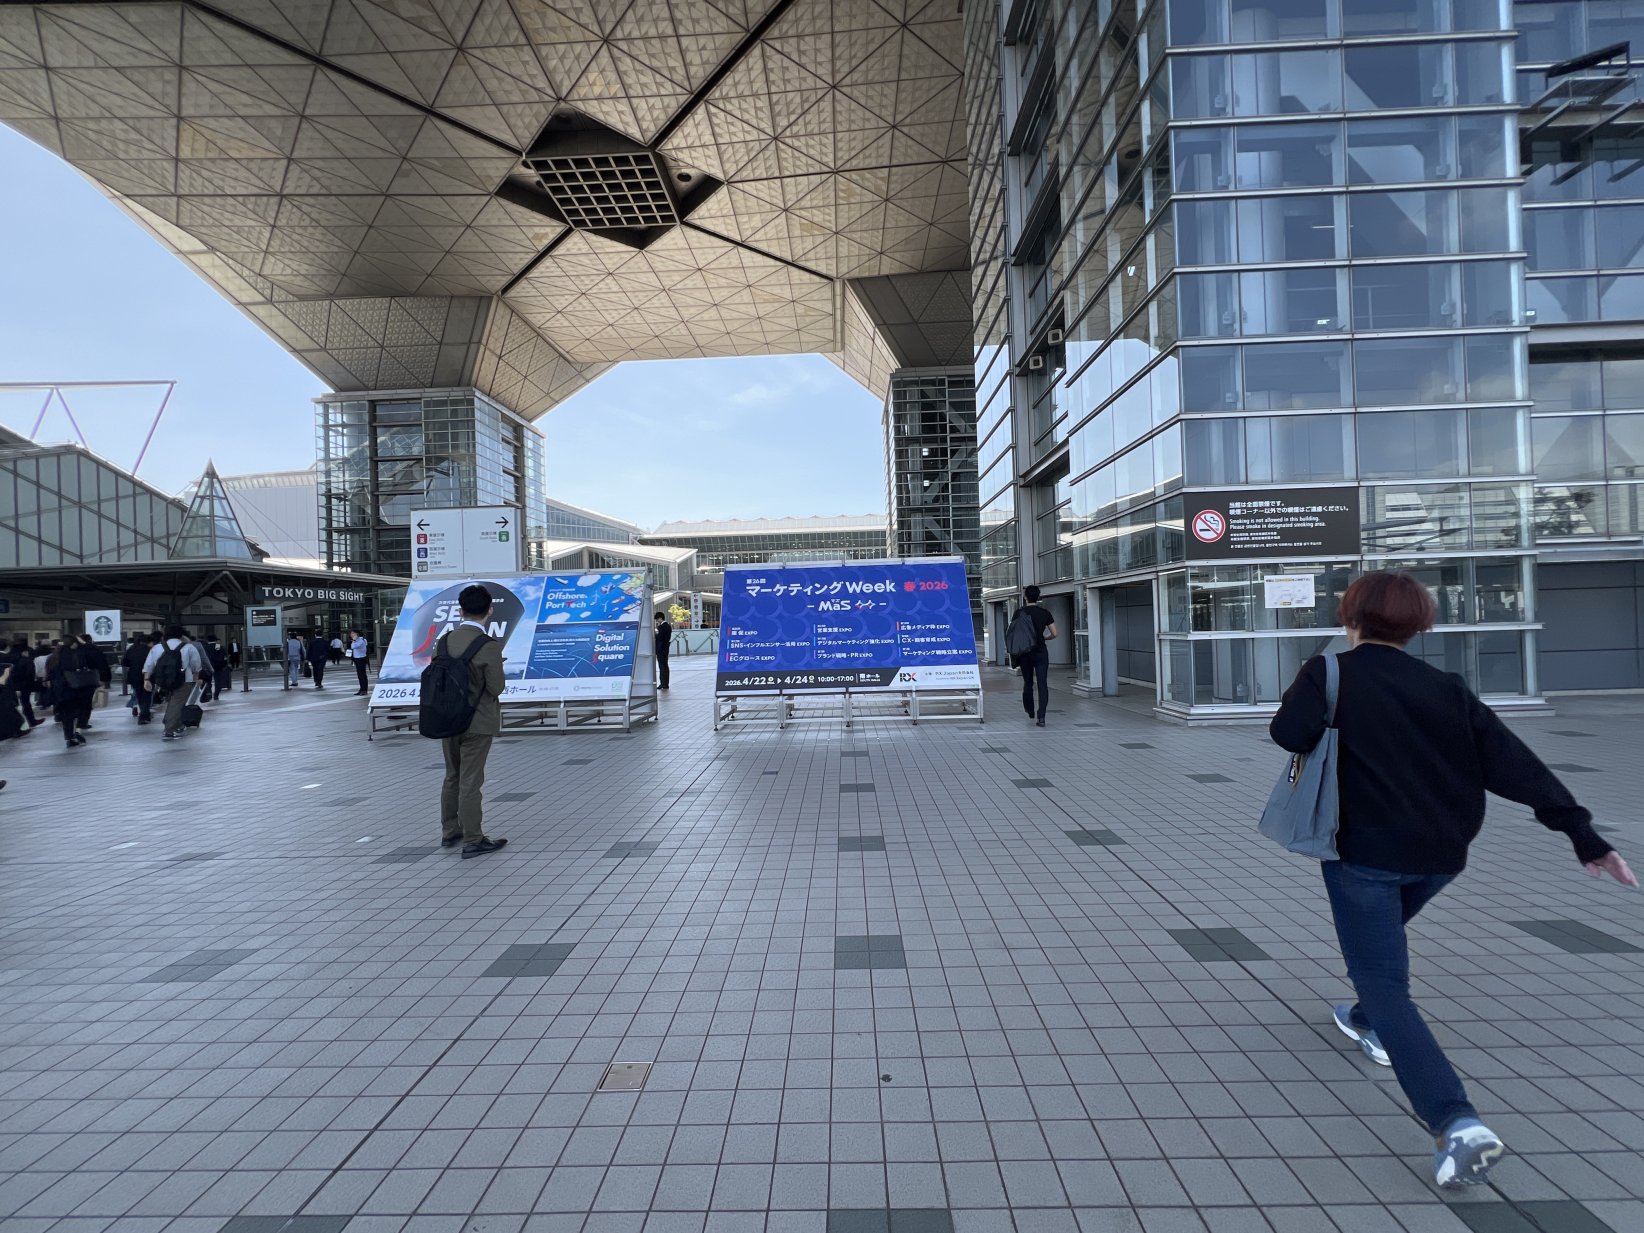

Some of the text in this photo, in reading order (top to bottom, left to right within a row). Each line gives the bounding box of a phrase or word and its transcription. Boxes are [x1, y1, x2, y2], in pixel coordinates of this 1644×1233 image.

[919, 581, 949, 591] 2026
[262, 587, 364, 601] TOKYO BIG SIGHT
[545, 601, 565, 610] Port
[595, 632, 625, 643] Digital
[593, 643, 630, 652] Solution
[784, 676, 808, 684] 4/24
[817, 675, 854, 683] 10:00-17:00
[378, 688, 407, 699] 2026
